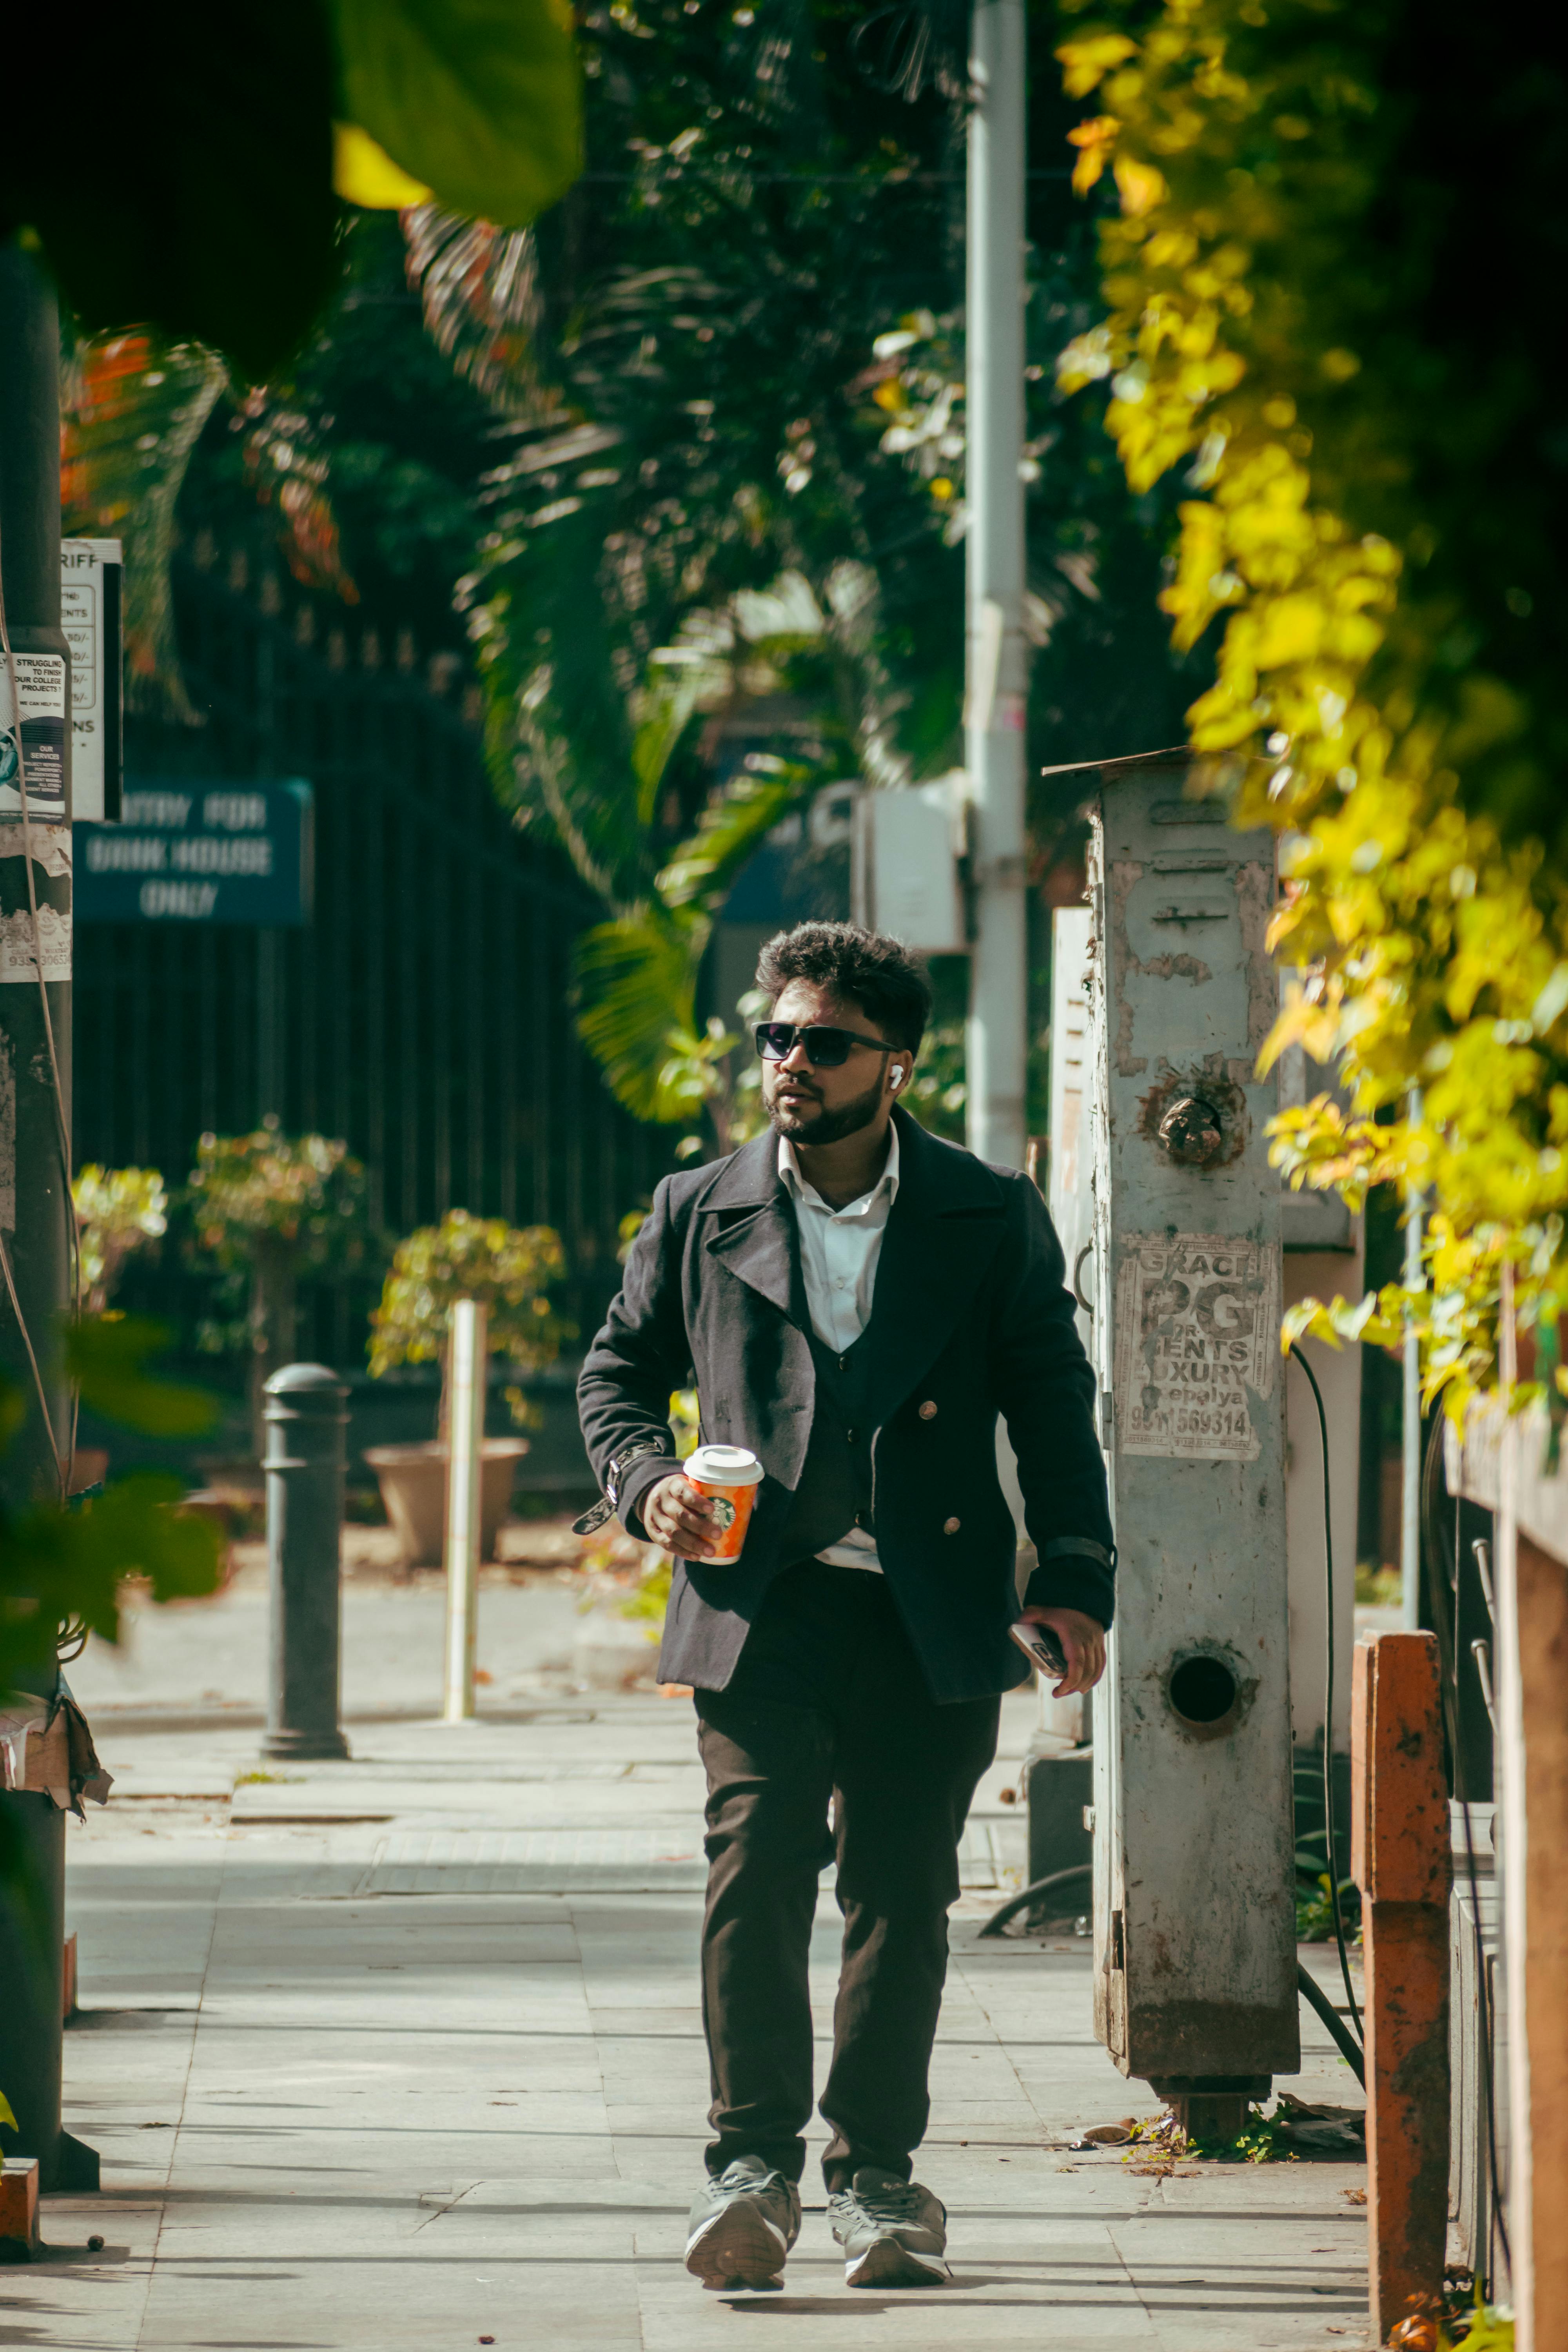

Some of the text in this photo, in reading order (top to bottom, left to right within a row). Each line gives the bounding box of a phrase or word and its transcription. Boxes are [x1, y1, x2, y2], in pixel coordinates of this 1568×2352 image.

[61, 554, 98, 568] RIFF
[16, 659, 62, 668] STRUGGLING
[1141, 1252, 1255, 1278] GRACE
[1141, 1278, 1255, 1341] PG
[1169, 1385, 1243, 1408] epalya
